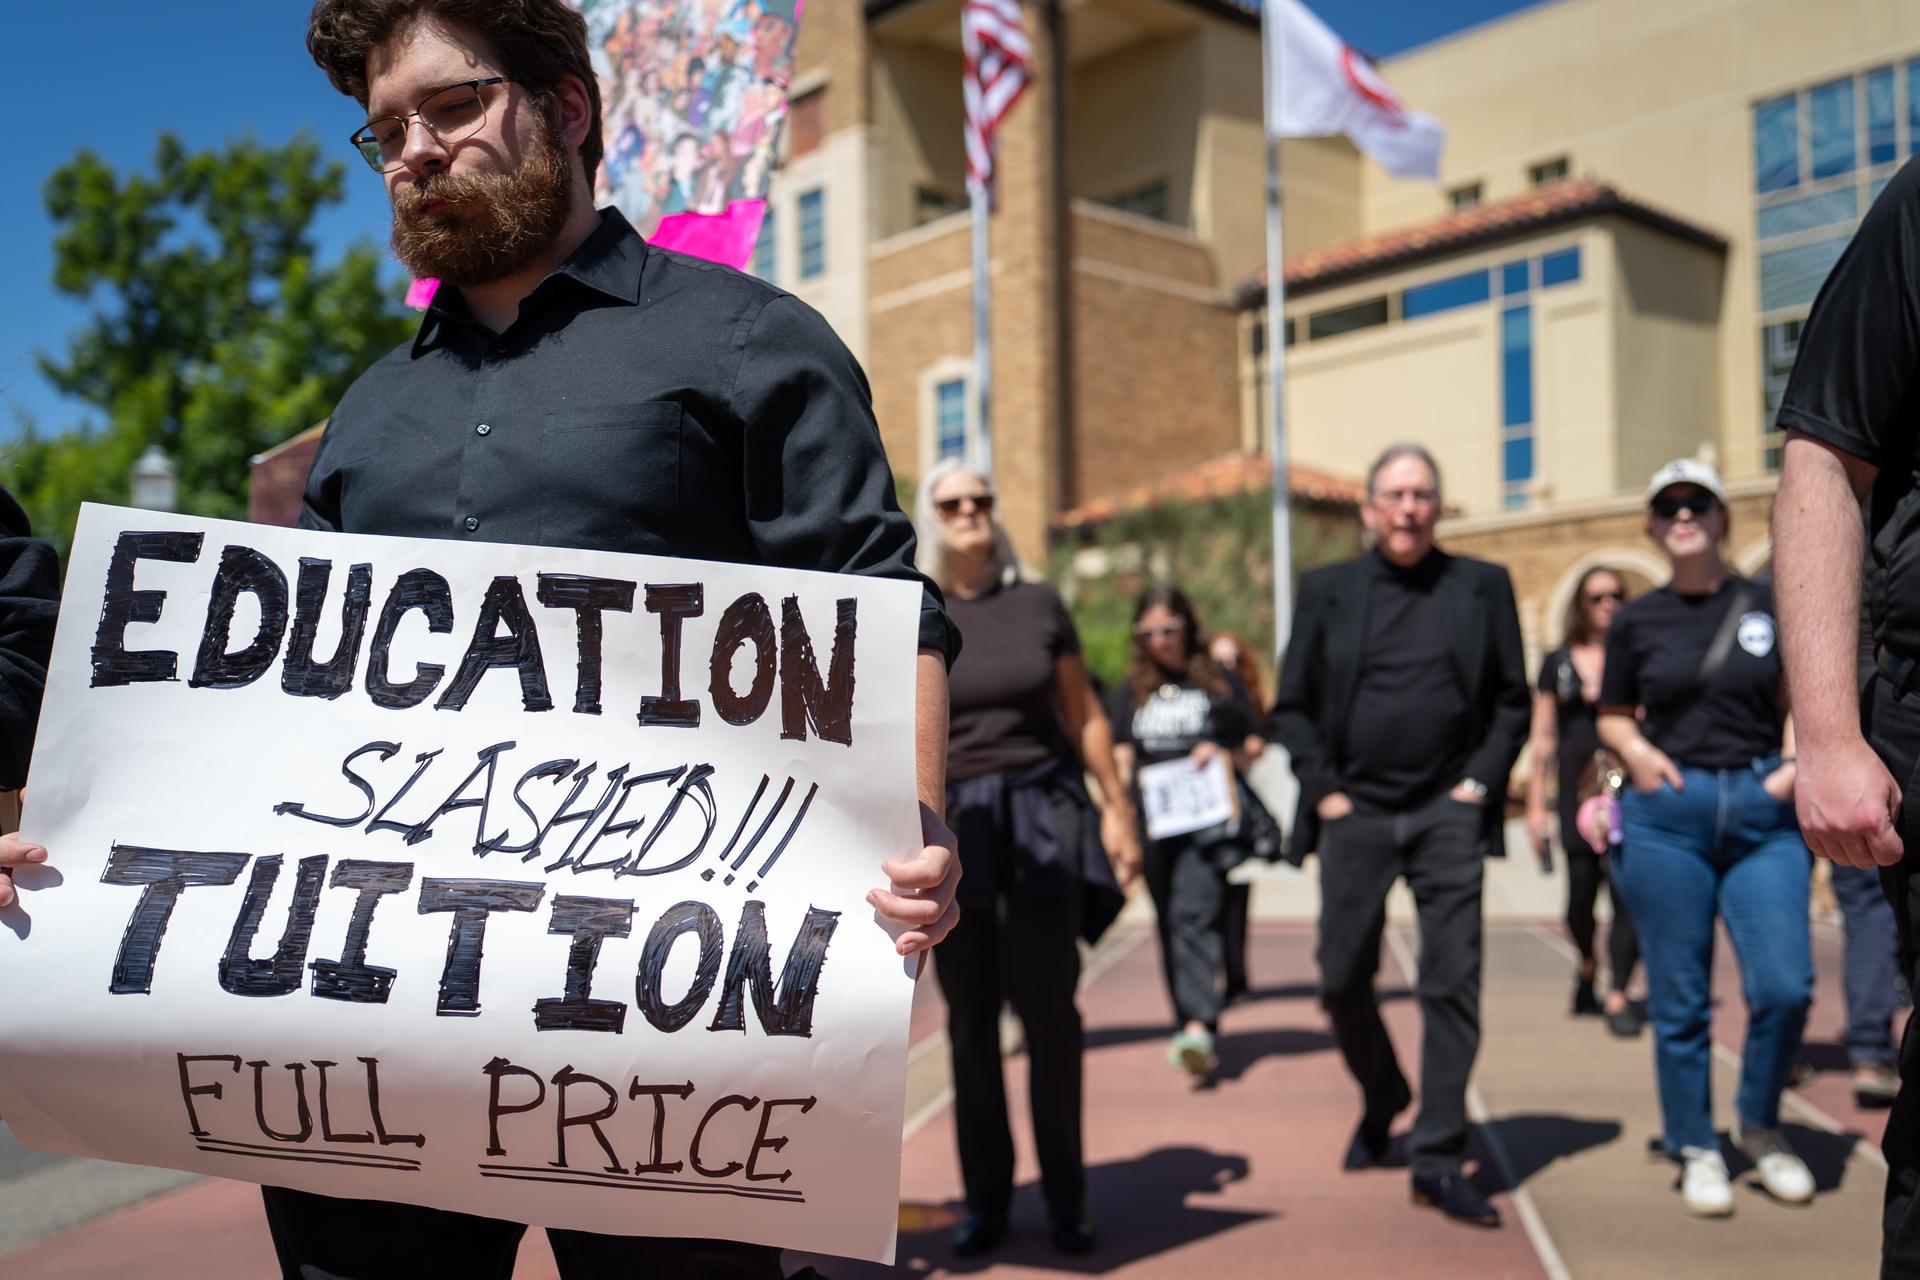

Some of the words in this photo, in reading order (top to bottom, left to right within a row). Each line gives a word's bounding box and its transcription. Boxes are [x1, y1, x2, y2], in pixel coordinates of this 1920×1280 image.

[90, 530, 857, 746] EDUCATION
[273, 741, 819, 891] SLASHED!!!
[100, 841, 842, 1037] TUITION
[176, 1053, 425, 1147] FULL
[483, 1057, 815, 1183] PRICE
